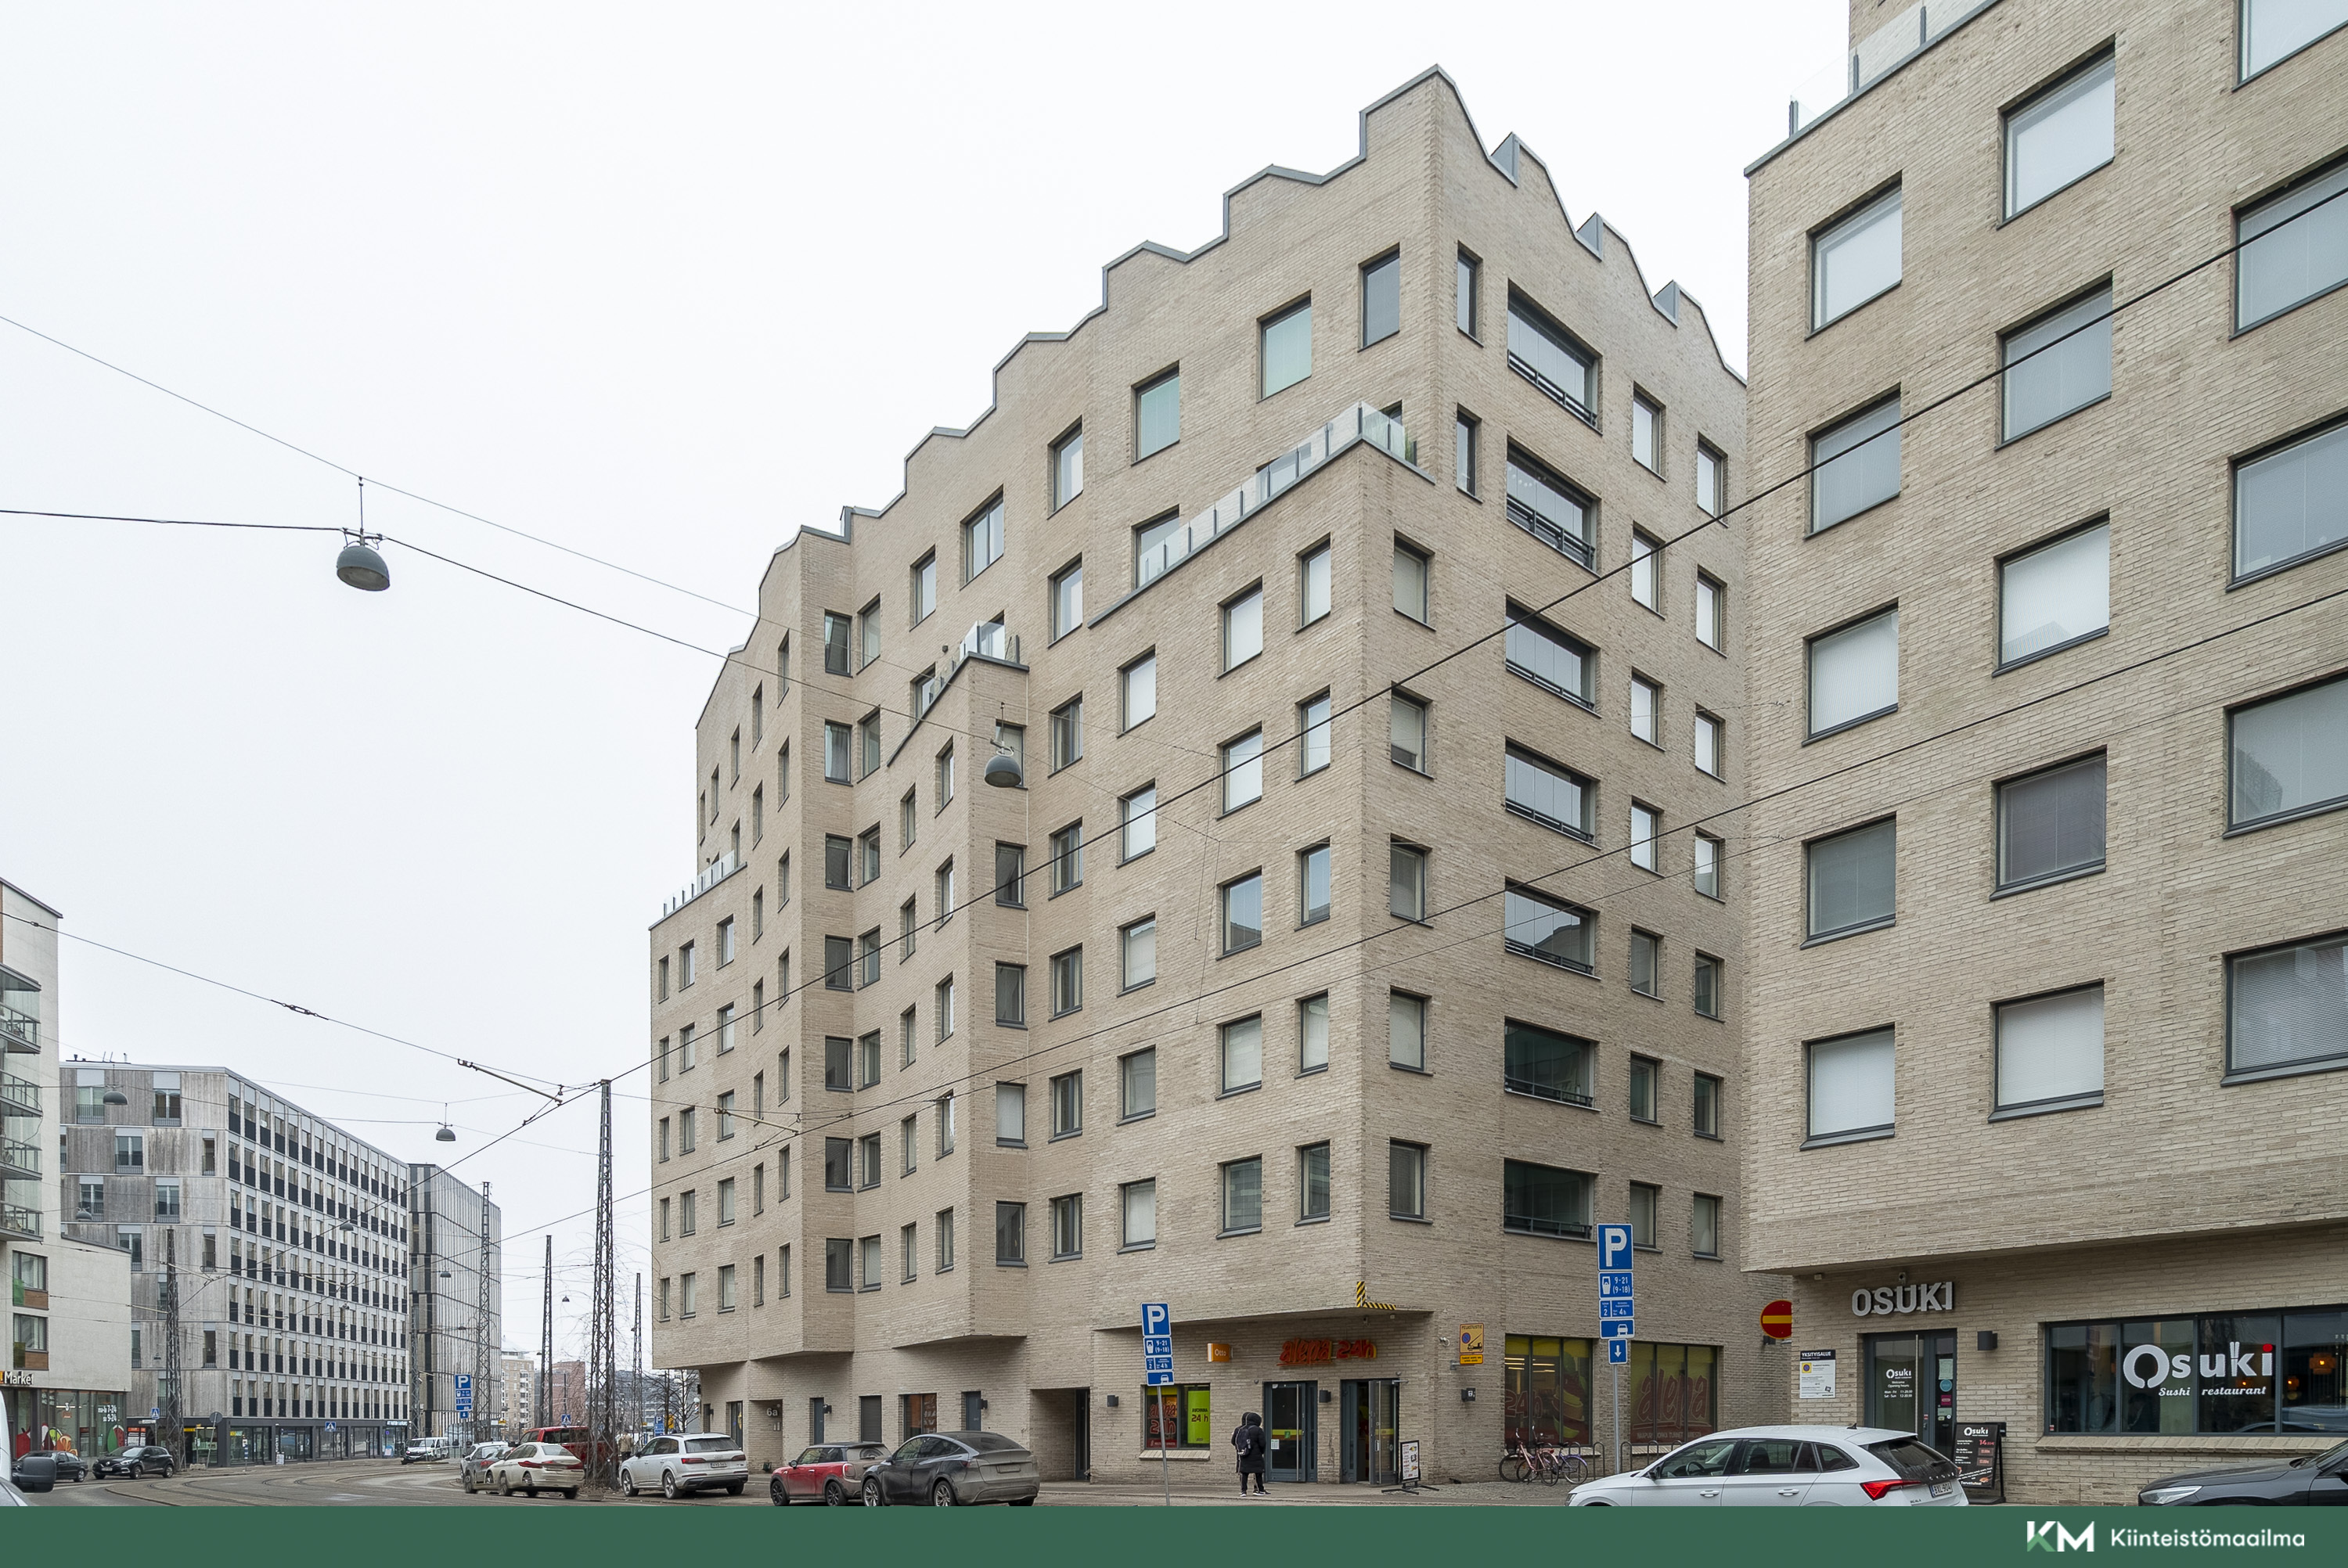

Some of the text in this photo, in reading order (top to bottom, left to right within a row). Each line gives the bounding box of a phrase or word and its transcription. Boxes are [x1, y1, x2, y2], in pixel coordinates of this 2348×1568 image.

[1604, 1228, 1627, 1267] P
[1612, 1286, 1630, 1294] (9-18)
[1852, 1282, 1953, 1317] OSUKI
[1147, 1305, 1165, 1334] P
[1214, 1348, 1226, 1357] Otto
[1278, 1338, 1377, 1365] alepa 24h
[2123, 1341, 2274, 1389] Osuki
[4, 1371, 34, 1385] Market
[1886, 1368, 1911, 1379] Osuki
[458, 1376, 469, 1388] P
[2159, 1386, 2267, 1397] Sushi restaurant
[1637, 1368, 1709, 1430] alepa
[1204, 1414, 1208, 1422] h
[1964, 1427, 1989, 1437] Osuki
